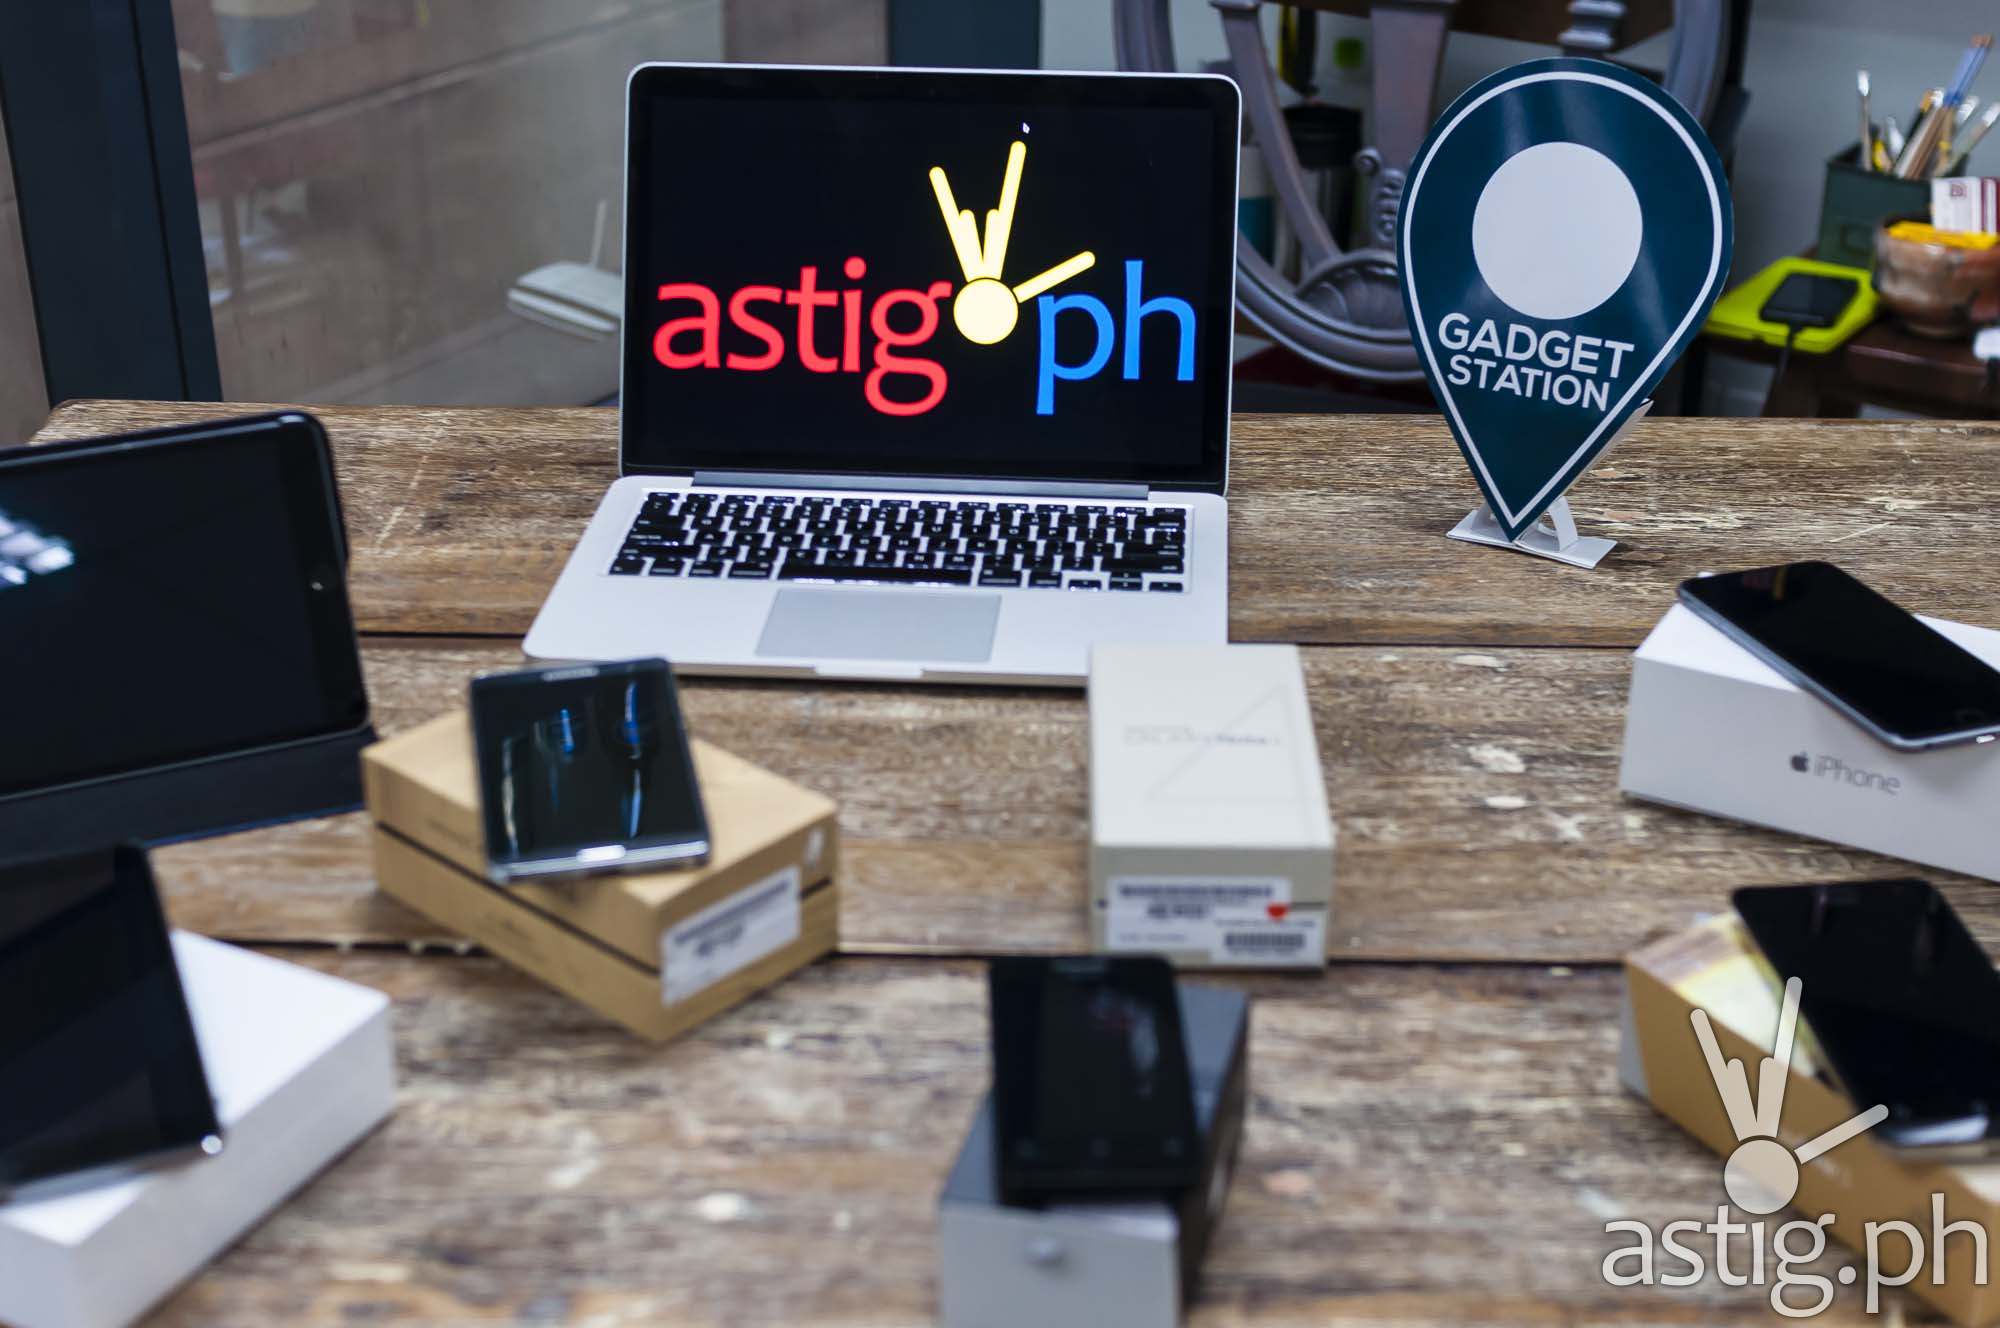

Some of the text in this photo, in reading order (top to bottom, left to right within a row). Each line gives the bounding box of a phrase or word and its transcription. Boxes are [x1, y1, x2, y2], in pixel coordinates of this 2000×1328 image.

[1438, 312, 1635, 379] GADGET
[1447, 354, 1610, 412] STATION
[1815, 754, 1901, 795] iPhone
